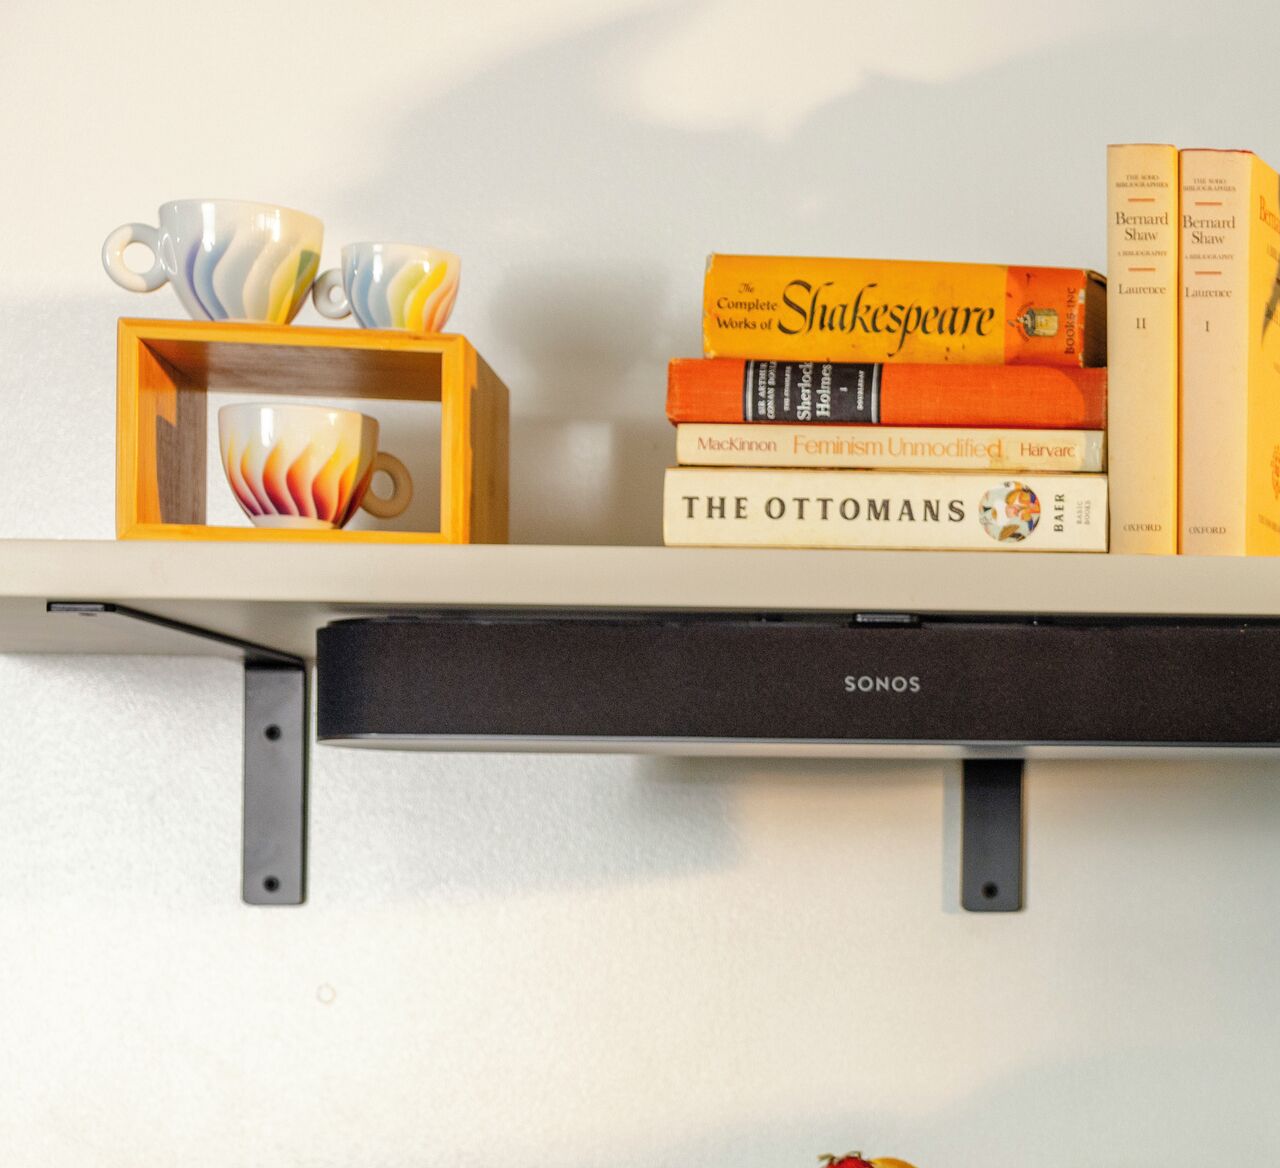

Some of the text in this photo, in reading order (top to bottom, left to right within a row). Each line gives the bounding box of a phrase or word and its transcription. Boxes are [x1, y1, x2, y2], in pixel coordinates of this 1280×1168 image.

[1115, 211, 1169, 225] Bernard
[1183, 215, 1236, 229] Bernard
[1124, 227, 1159, 241] Shaw
[1191, 231, 1226, 245] Shaw
[1118, 284, 1167, 295] Laurence
[1185, 287, 1233, 298] Laurence
[716, 297, 778, 313] Complete
[716, 316, 774, 331] Works of
[777, 279, 995, 358] Shakespeare
[1135, 317, 1147, 330] II
[796, 361, 814, 421] Sherlock
[815, 363, 832, 418] Holmes
[757, 399, 767, 416] SIR
[766, 387, 776, 420] CONAN
[697, 436, 777, 452] MacKinnon
[793, 434, 883, 456] Feminism
[888, 437, 1003, 459] Unmodified
[682, 495, 966, 523] THE OTTOMANS
[1053, 493, 1065, 533] BAER
[1123, 522, 1163, 532] OXFORD
[1188, 525, 1227, 535] OXFORD
[843, 674, 922, 693] SONOS
